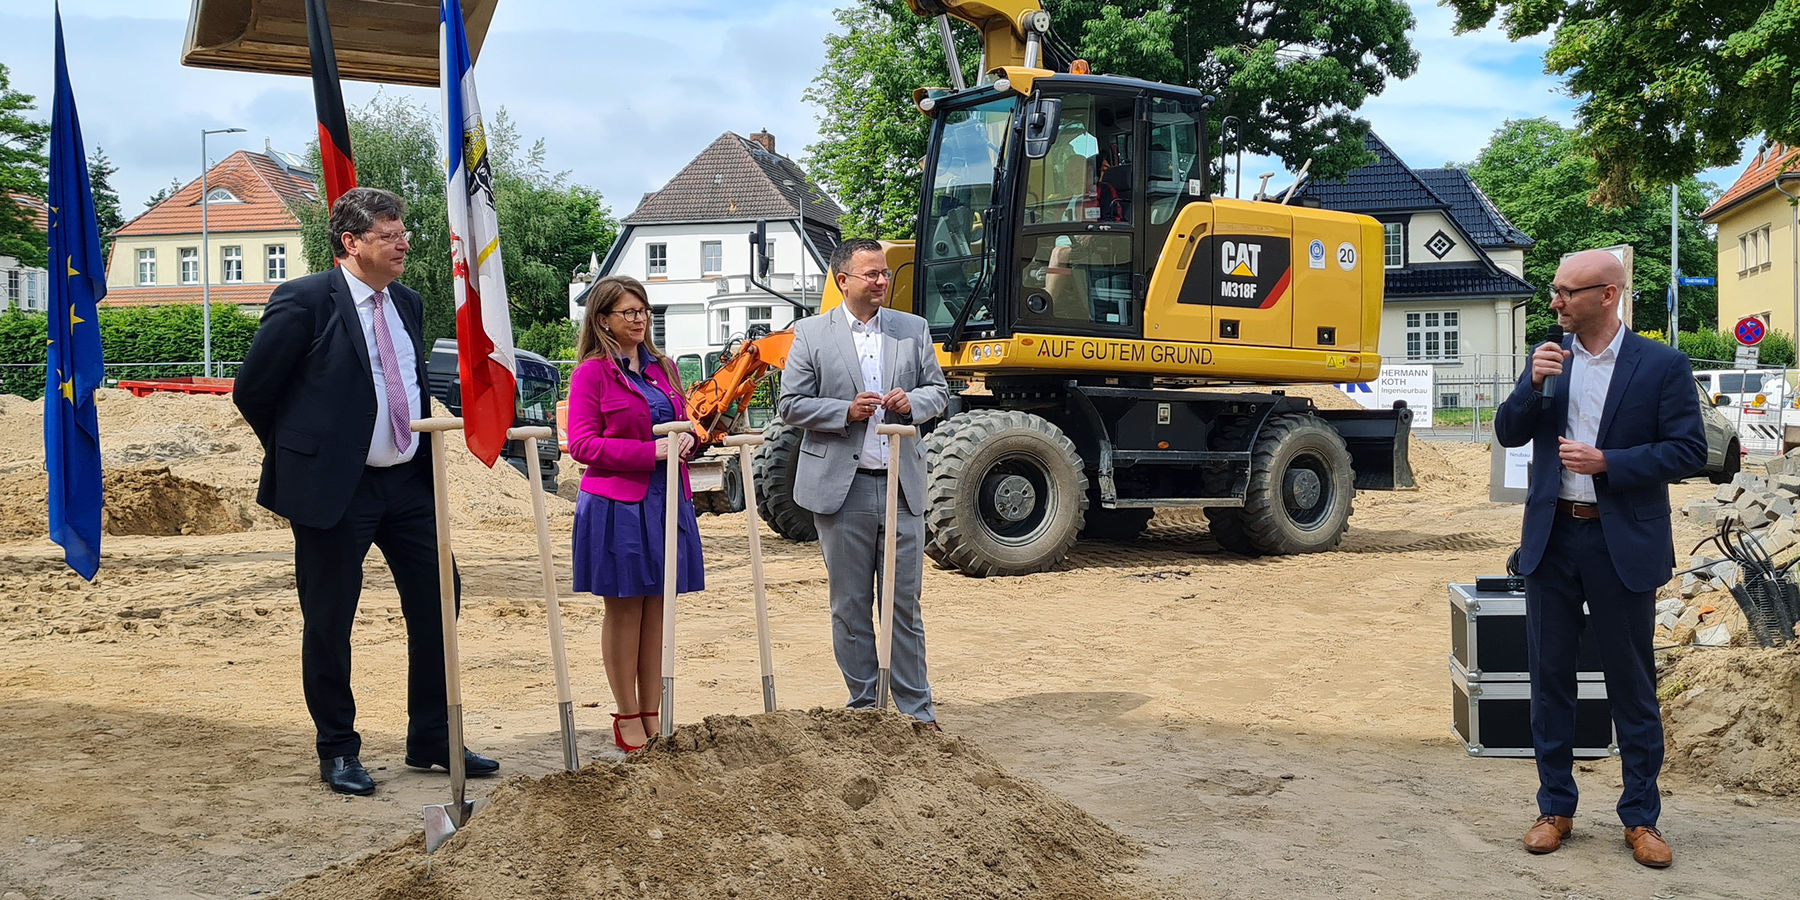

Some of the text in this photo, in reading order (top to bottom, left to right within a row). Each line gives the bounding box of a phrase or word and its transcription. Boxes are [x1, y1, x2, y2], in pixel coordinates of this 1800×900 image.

[1221, 240, 1261, 277] CAT
[1339, 248, 1355, 264] 20
[1221, 281, 1257, 299] M318F
[1037, 339, 1216, 366] AUF GUTEM GRUND.
[1381, 369, 1428, 377] HERMANN
[1381, 387, 1428, 395] Ingenieurbau
